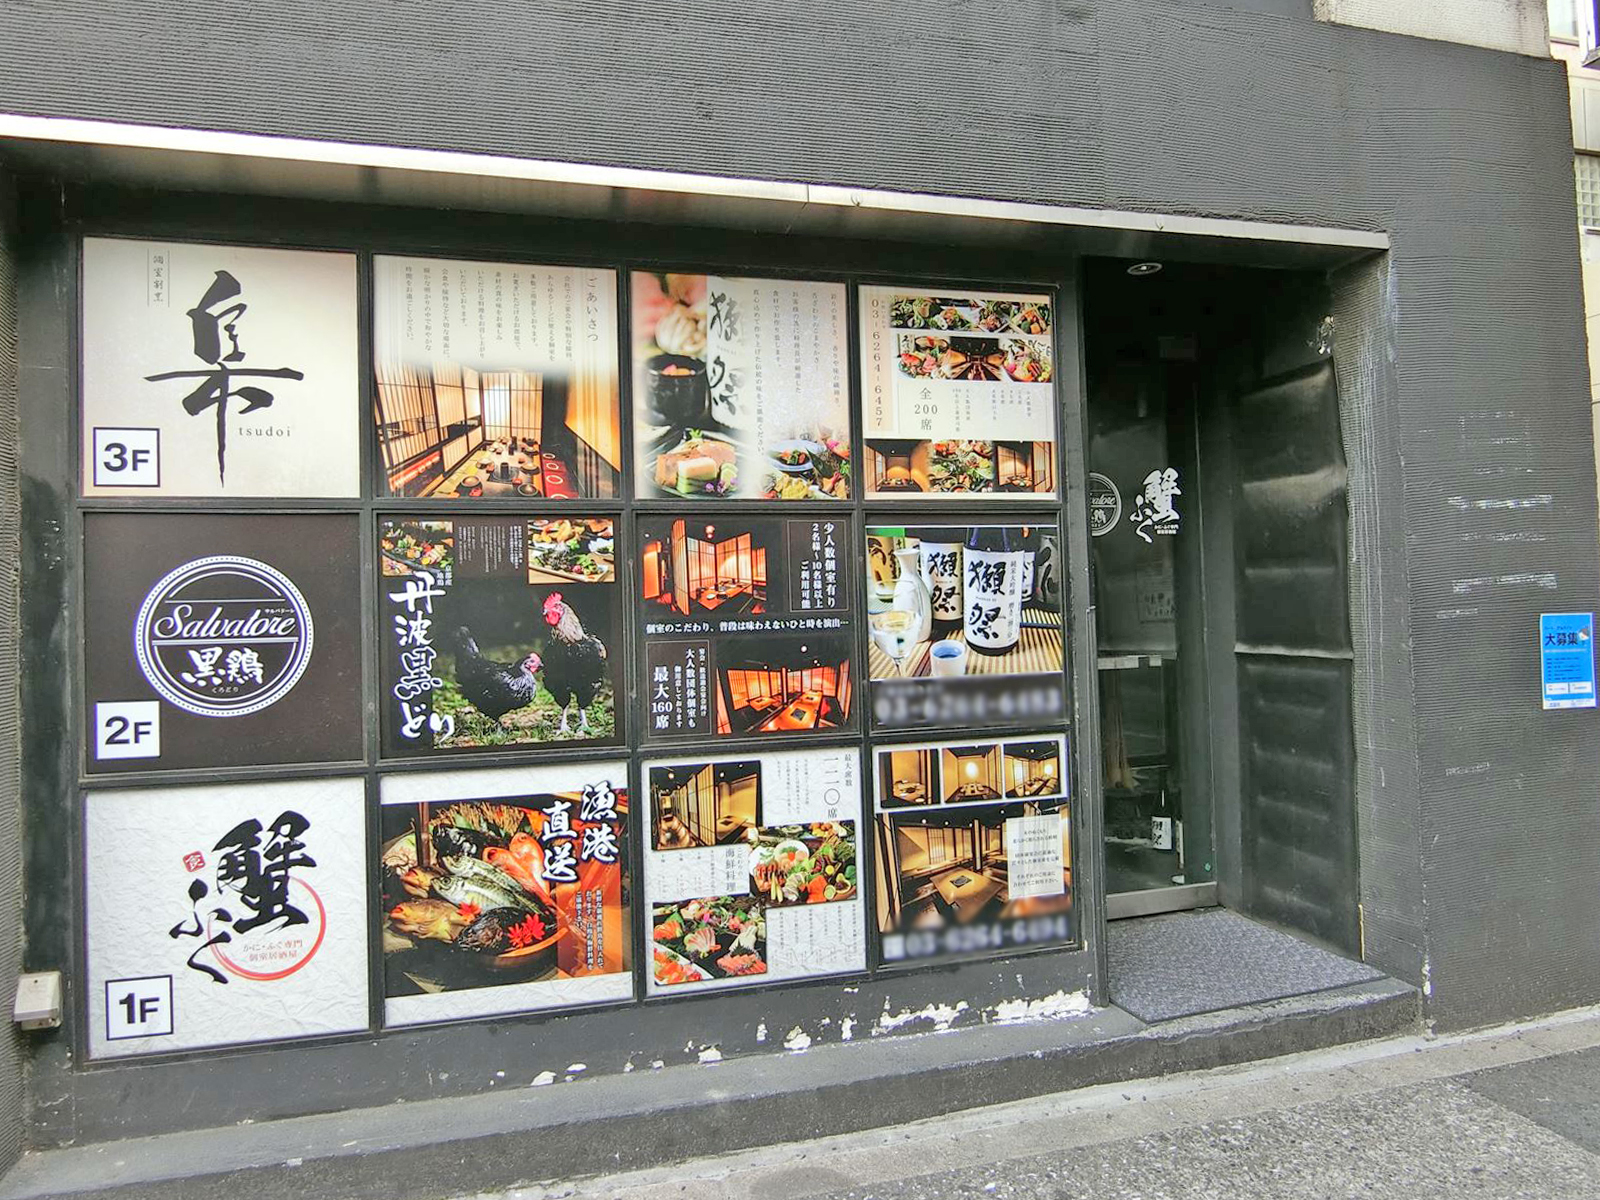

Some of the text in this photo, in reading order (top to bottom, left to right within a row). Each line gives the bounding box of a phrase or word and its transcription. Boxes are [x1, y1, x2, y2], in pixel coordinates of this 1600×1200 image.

[586, 277, 599, 342] ごあいさつ
[239, 425, 292, 437] tsudoi
[103, 442, 151, 472] 3F
[800, 560, 812, 609] ご利用可能
[823, 521, 838, 609] 少人数個室有り
[153, 604, 296, 639] Salvatore
[1544, 632, 1578, 646] 大募集
[181, 646, 263, 687] 黒鶏
[686, 648, 697, 728] 大人数団体個室も
[105, 716, 152, 745] 2F
[541, 800, 579, 883] 直送
[580, 780, 619, 863] 漁港
[119, 992, 160, 1025] 1F
